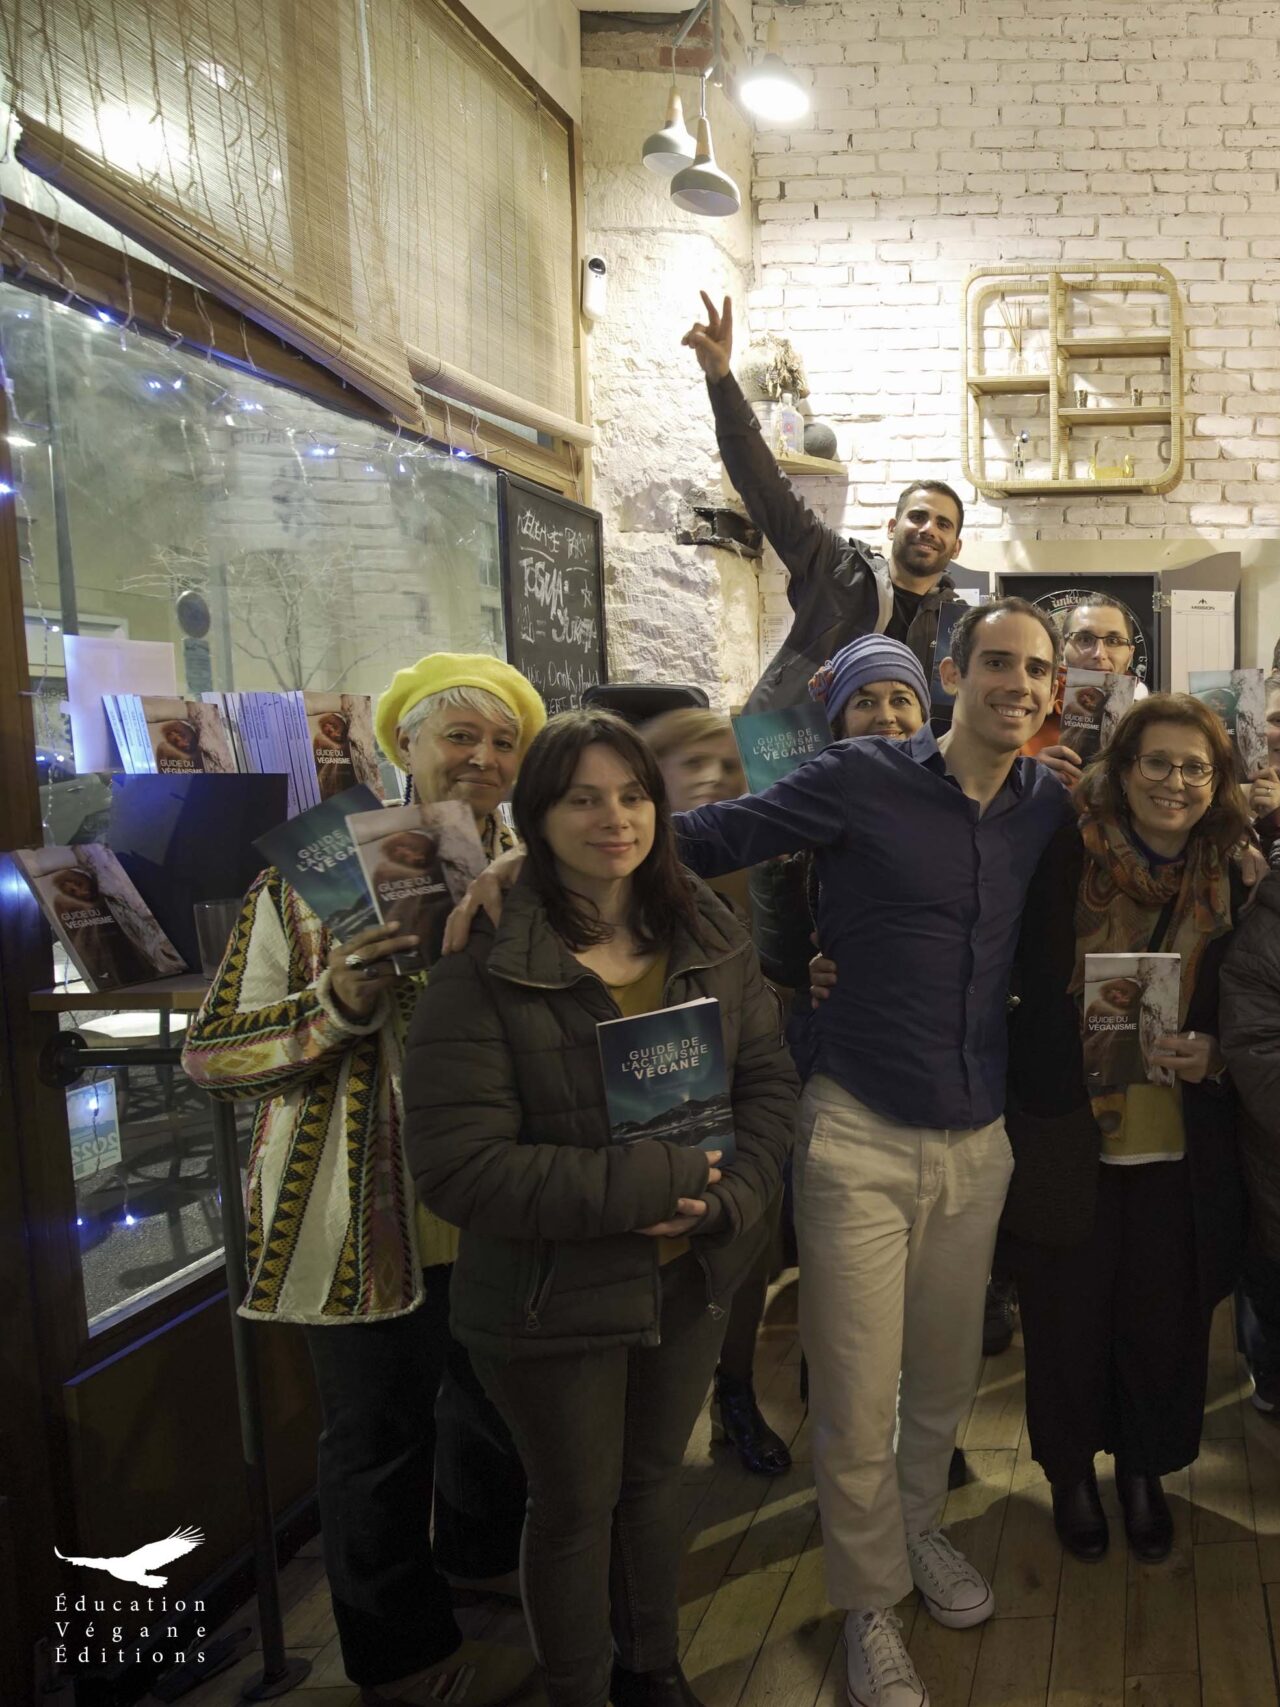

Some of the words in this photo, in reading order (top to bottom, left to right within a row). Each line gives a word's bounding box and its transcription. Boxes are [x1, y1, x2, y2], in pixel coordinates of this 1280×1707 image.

[1064, 714, 1082, 722] GUIDE
[1084, 715, 1094, 724] DU
[752, 734, 820, 755] L'ACTIVISME
[757, 732, 792, 746] GUIDE
[797, 728, 812, 738] DE
[160, 760, 182, 768] GUIDE
[298, 828, 344, 860] GUIDE
[378, 878, 414, 894] GUIDE
[414, 876, 432, 888] DU
[61, 910, 88, 921] GUIDE
[88, 908, 102, 918] DU
[622, 1044, 708, 1072] L'ACTIVISME
[629, 1042, 675, 1061] GUIDE
[681, 1036, 700, 1049] DE
[634, 1056, 700, 1080] VÉGANE
